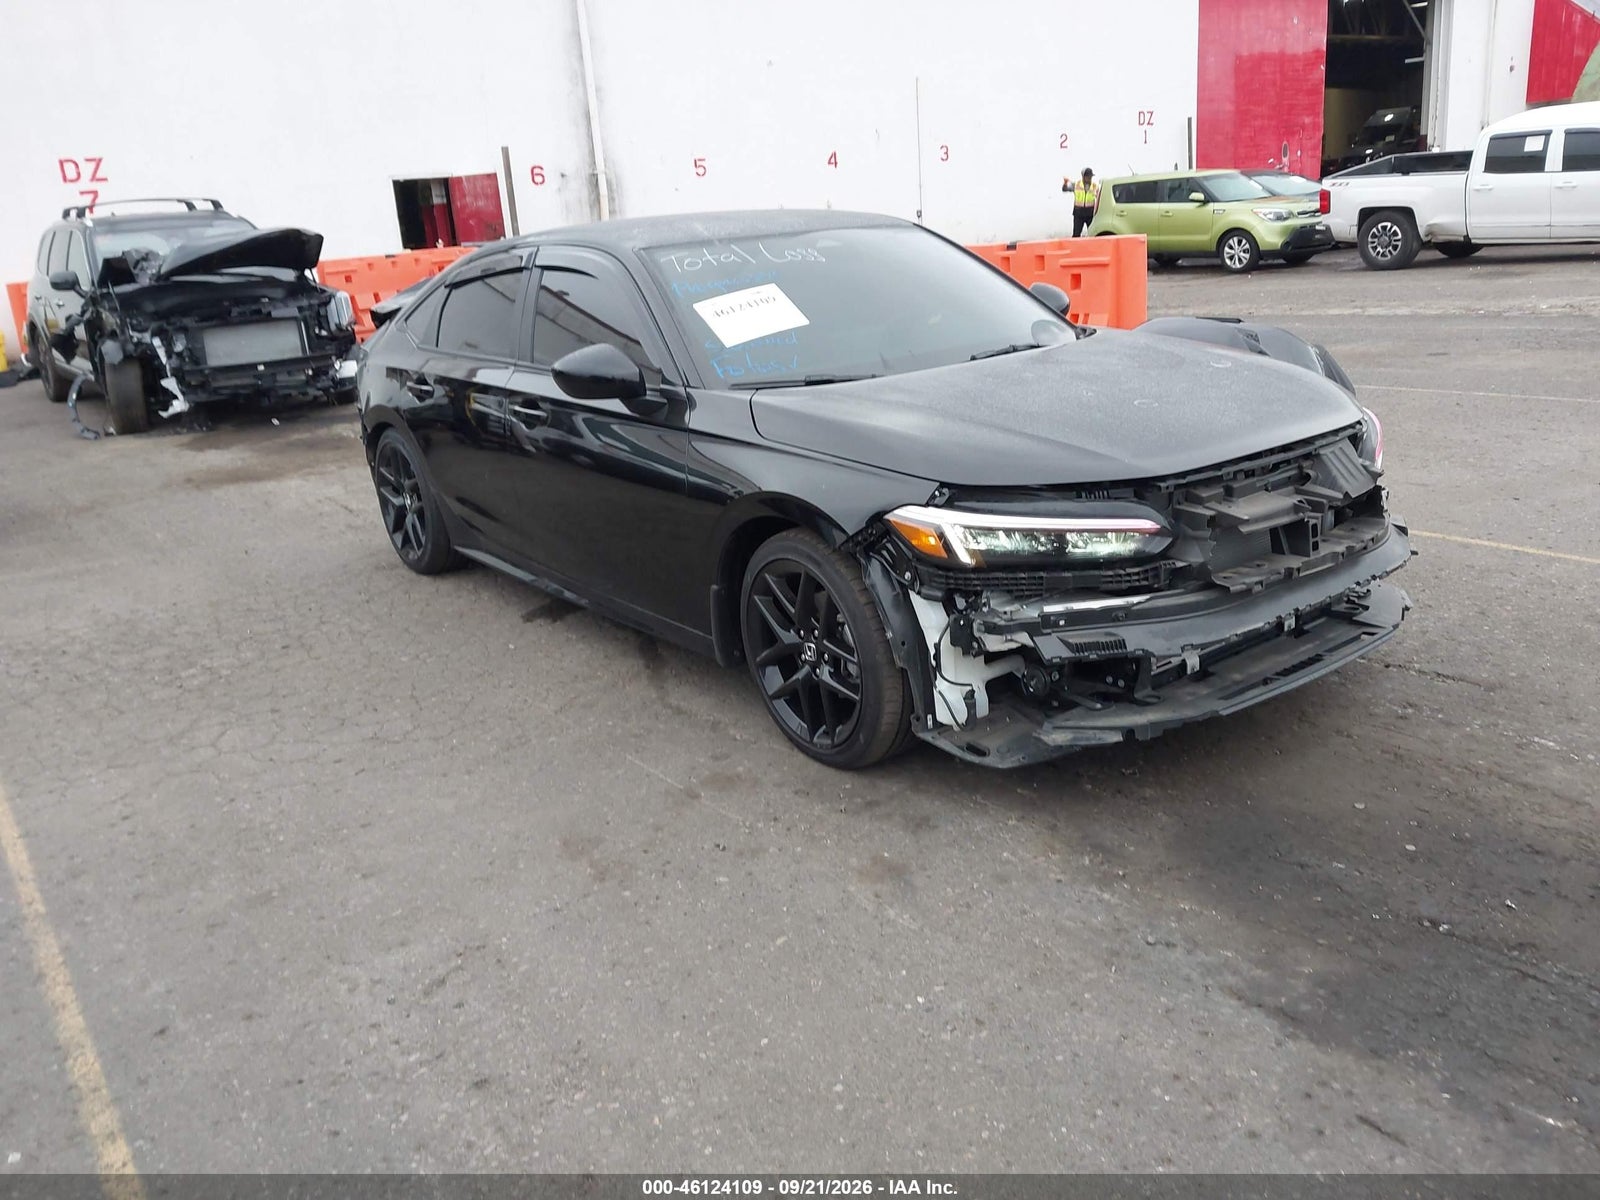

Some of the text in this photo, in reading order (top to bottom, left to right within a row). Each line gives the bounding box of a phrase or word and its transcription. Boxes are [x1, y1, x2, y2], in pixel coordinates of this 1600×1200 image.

[1138, 110, 1154, 126] DZ
[1060, 133, 1068, 149] 2
[1143, 129, 1148, 144] 1
[827, 151, 838, 169] 4
[940, 144, 949, 161] 3
[58, 157, 108, 184] DZ
[530, 165, 546, 186] 6
[694, 157, 707, 177] 5
[79, 189, 99, 215] 7
[661, 244, 756, 273] Total
